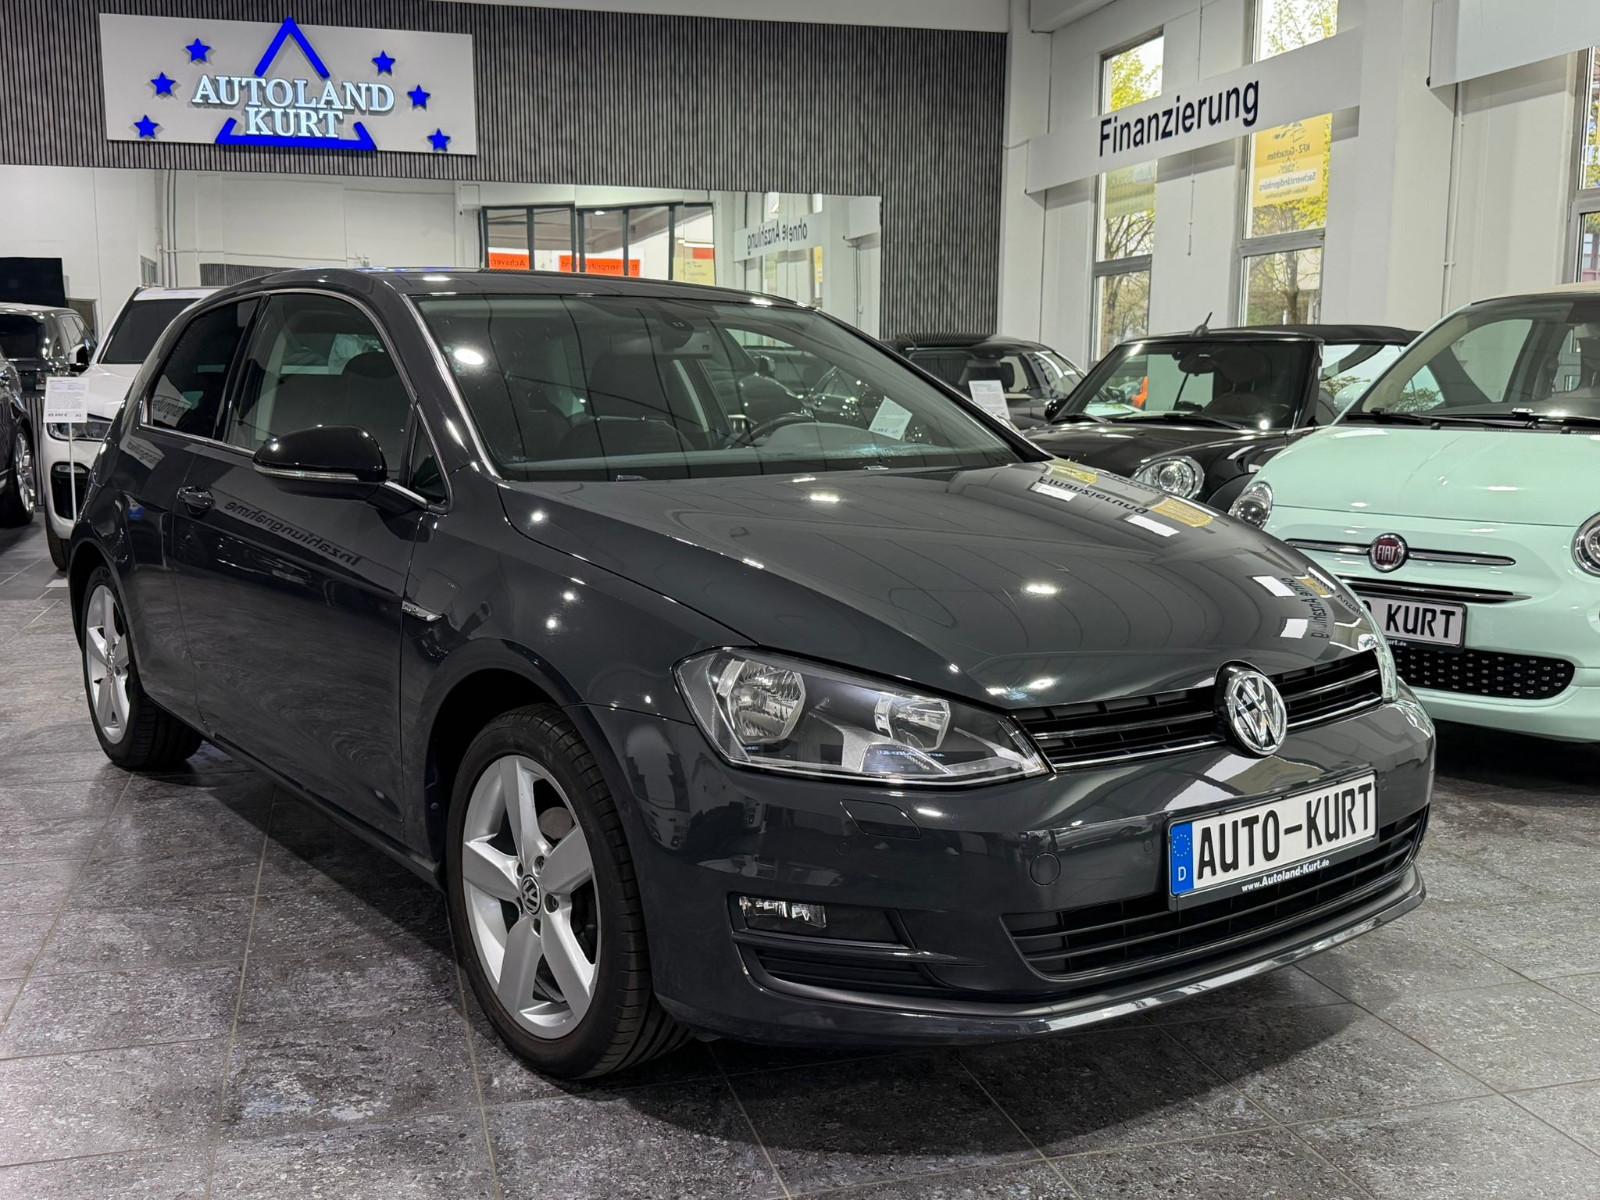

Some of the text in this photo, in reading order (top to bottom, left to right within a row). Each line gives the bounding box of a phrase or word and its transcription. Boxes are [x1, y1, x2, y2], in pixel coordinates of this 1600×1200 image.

[191, 75, 395, 112] AUTOLAND
[245, 107, 344, 139] KURT
[1099, 80, 1259, 157] Finanzierung
[1377, 544, 1398, 559] FIAT
[1385, 603, 1456, 639] KURT
[1197, 782, 1373, 880] AUTO-KURT
[1178, 866, 1187, 882] D
[1241, 858, 1330, 893] www.Autoland-Kurt.de
